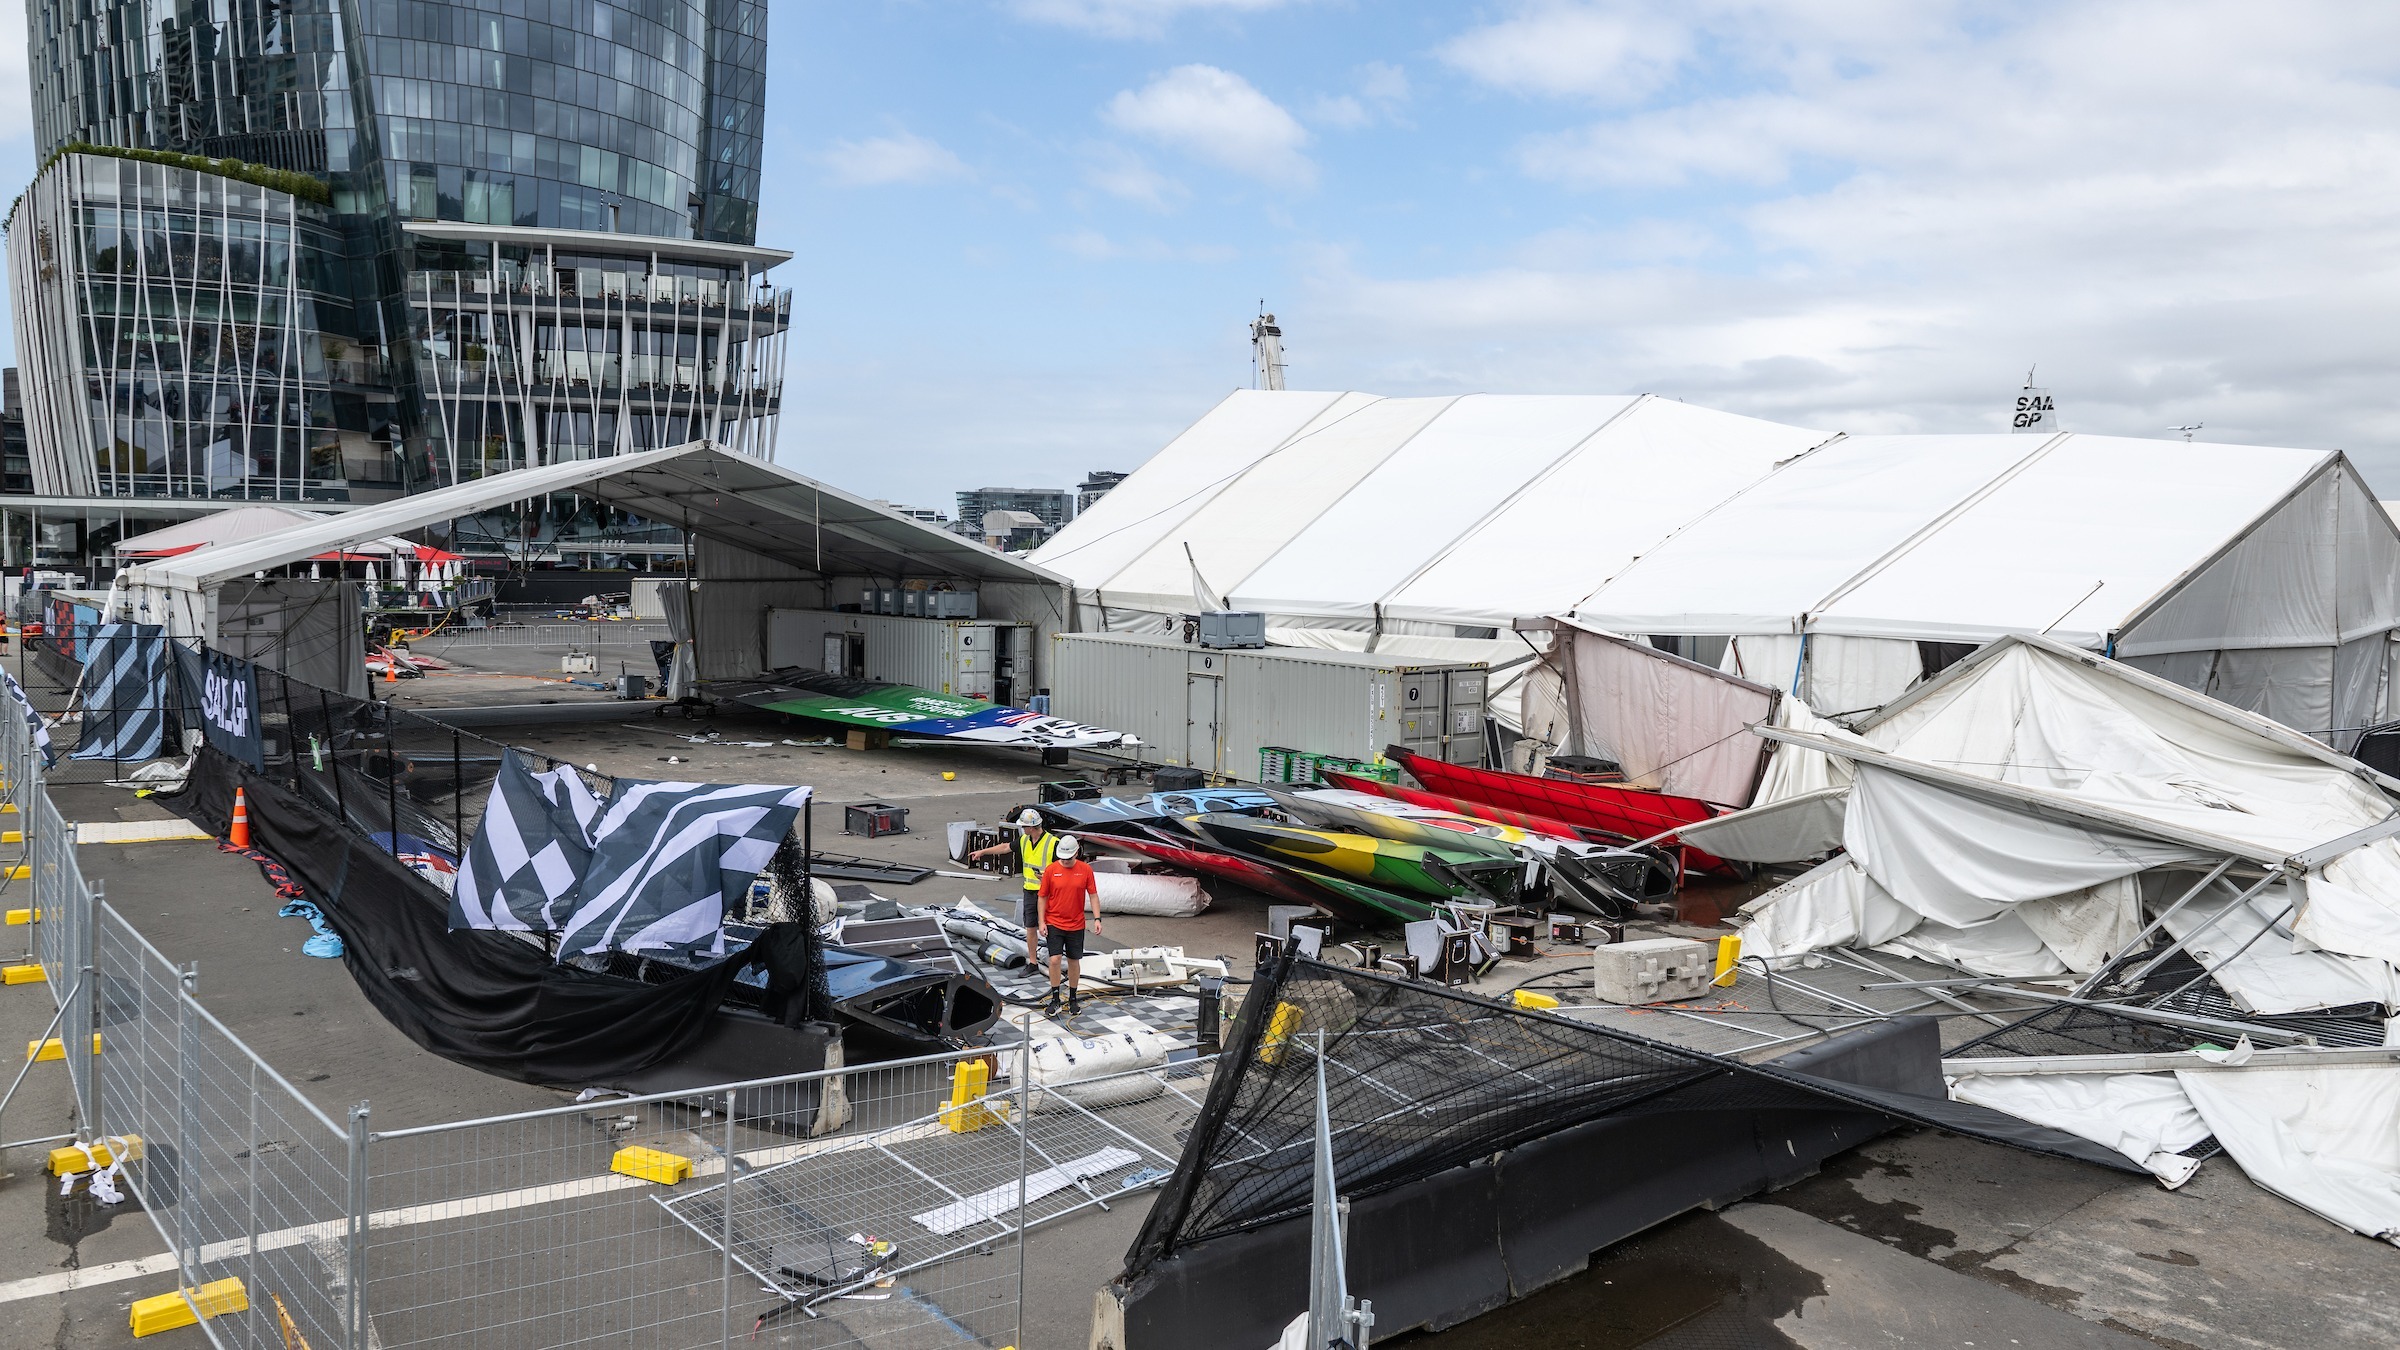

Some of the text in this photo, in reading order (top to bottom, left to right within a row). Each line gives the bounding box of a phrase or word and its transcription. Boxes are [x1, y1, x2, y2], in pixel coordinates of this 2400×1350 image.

[2016, 396, 2055, 412] SAIL
[2013, 412, 2042, 428] GP
[820, 706, 927, 723] AUS
